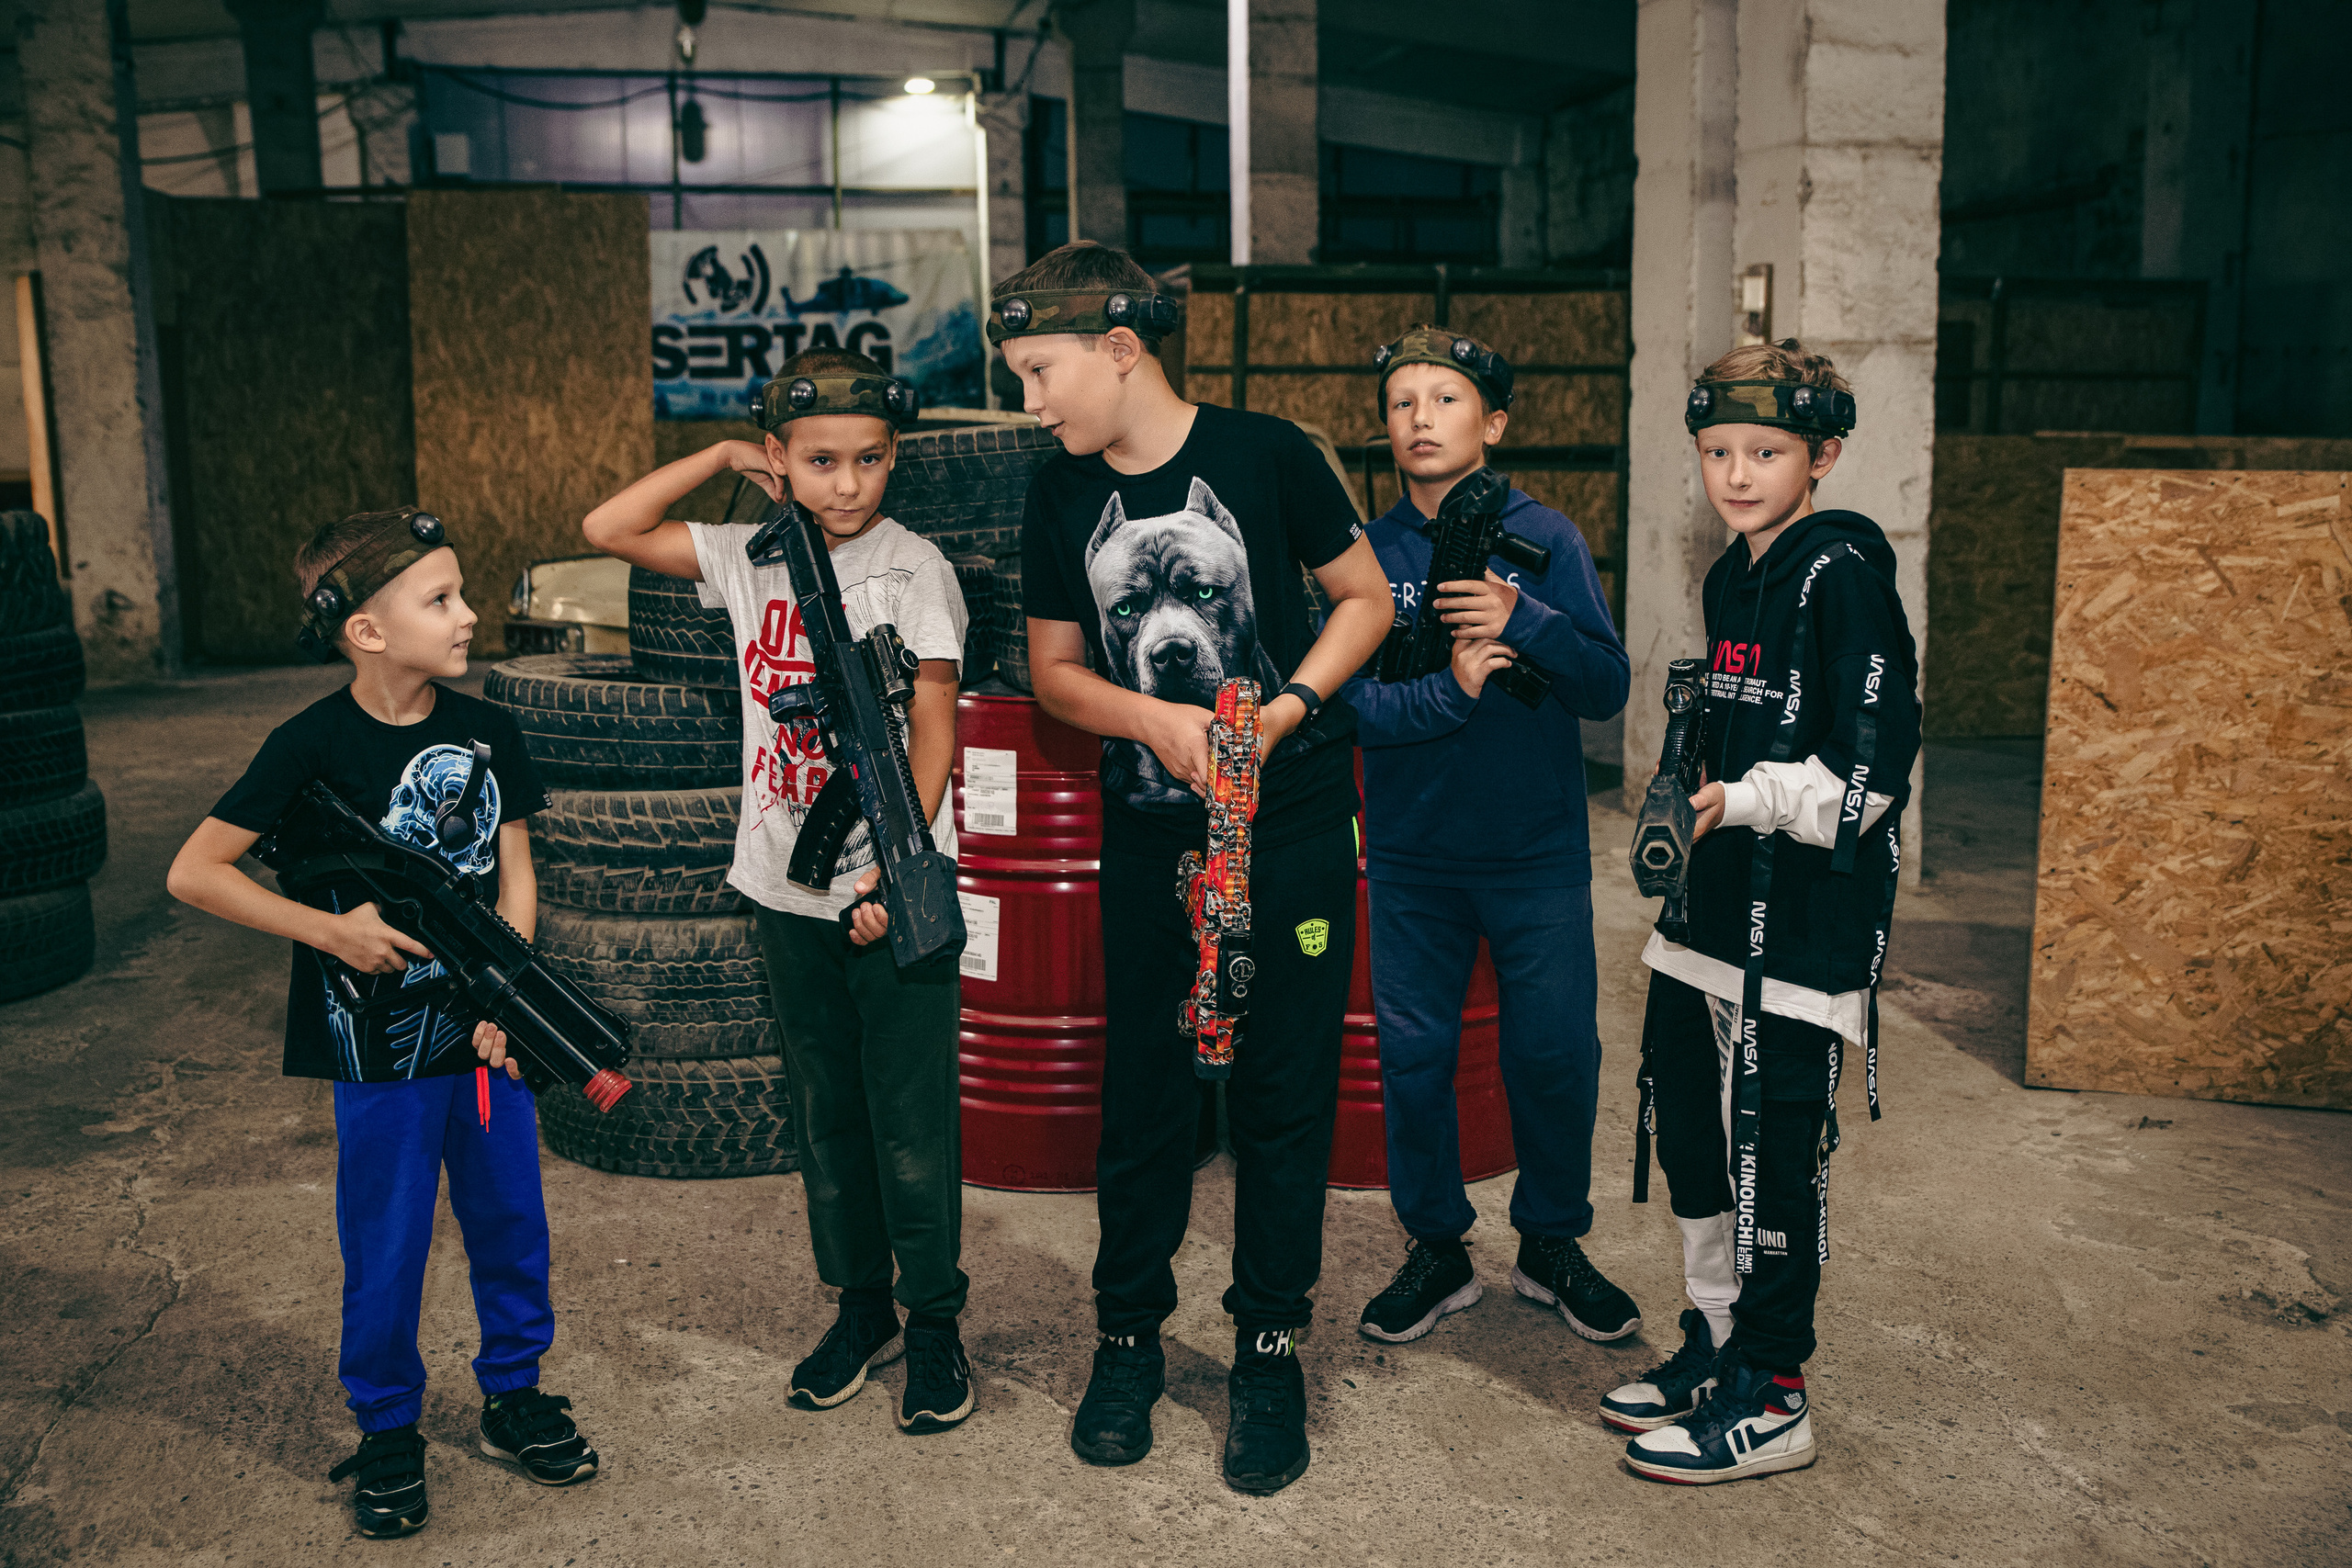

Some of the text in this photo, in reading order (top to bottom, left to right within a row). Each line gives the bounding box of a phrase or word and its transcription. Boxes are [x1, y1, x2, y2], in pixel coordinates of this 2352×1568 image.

[1799, 554, 1831, 608] NASA
[1765, 689, 1784, 700] FOR
[1781, 669, 1802, 726] NASA
[774, 724, 827, 761] NO
[1842, 764, 1871, 822] NASA
[1305, 926, 1322, 935] RULES
[1750, 900, 1767, 957] NASA
[1870, 930, 1886, 987] NASA
[1744, 1018, 1758, 1076] NASA
[1868, 1047, 1877, 1107] NASA
[1737, 1153, 1756, 1246] KINOUCHI
[1756, 1227, 1787, 1248] UND
